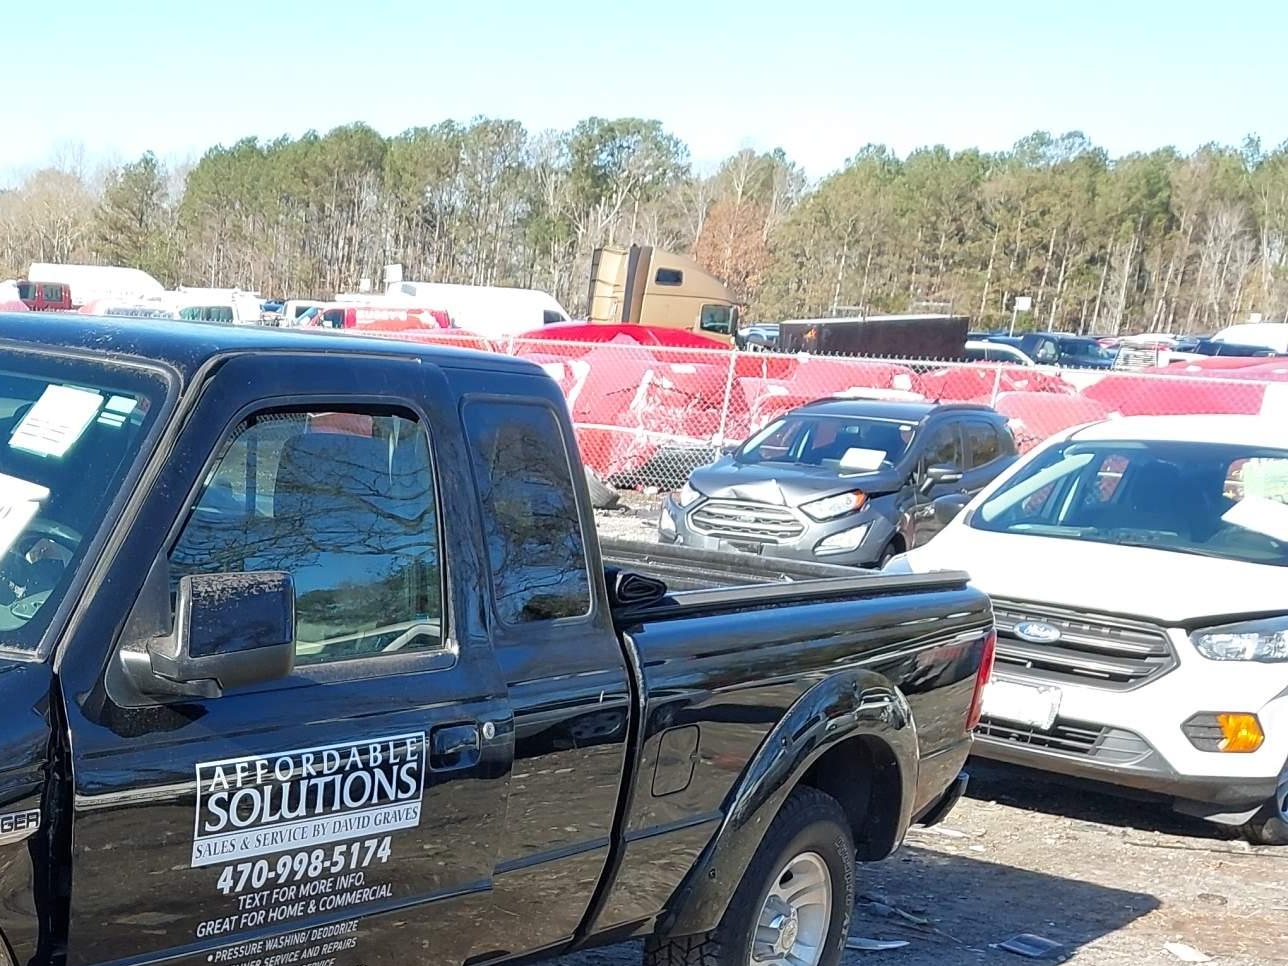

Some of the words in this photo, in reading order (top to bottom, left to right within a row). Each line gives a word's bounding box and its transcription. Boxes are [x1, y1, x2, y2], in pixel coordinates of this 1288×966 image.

[209, 738, 419, 791] AFFORDABLE
[205, 762, 418, 832] SOLUTIONS
[195, 839, 235, 860] SALES
[240, 837, 250, 849] &
[255, 826, 308, 848] SERVICE
[312, 823, 328, 837] BY
[332, 813, 370, 834] DAVID
[374, 806, 418, 827] GRAVES
[217, 836, 392, 894] 470-998-5174
[238, 891, 270, 910] TEXT
[272, 885, 296, 904] FOR
[299, 878, 334, 899] MORE
[336, 871, 365, 890] INFO.
[197, 916, 238, 937] GREAT
[240, 911, 264, 929] FOR
[268, 902, 304, 923] HOME
[307, 900, 316, 914] &
[319, 883, 392, 911] COMMERCIAL
[214, 941, 263, 963] PRESSURE
[265, 931, 310, 951] WASHING/
[311, 920, 359, 941] DEODORIZE
[300, 947, 320, 959] AND
[322, 937, 357, 955] REPAIRS
